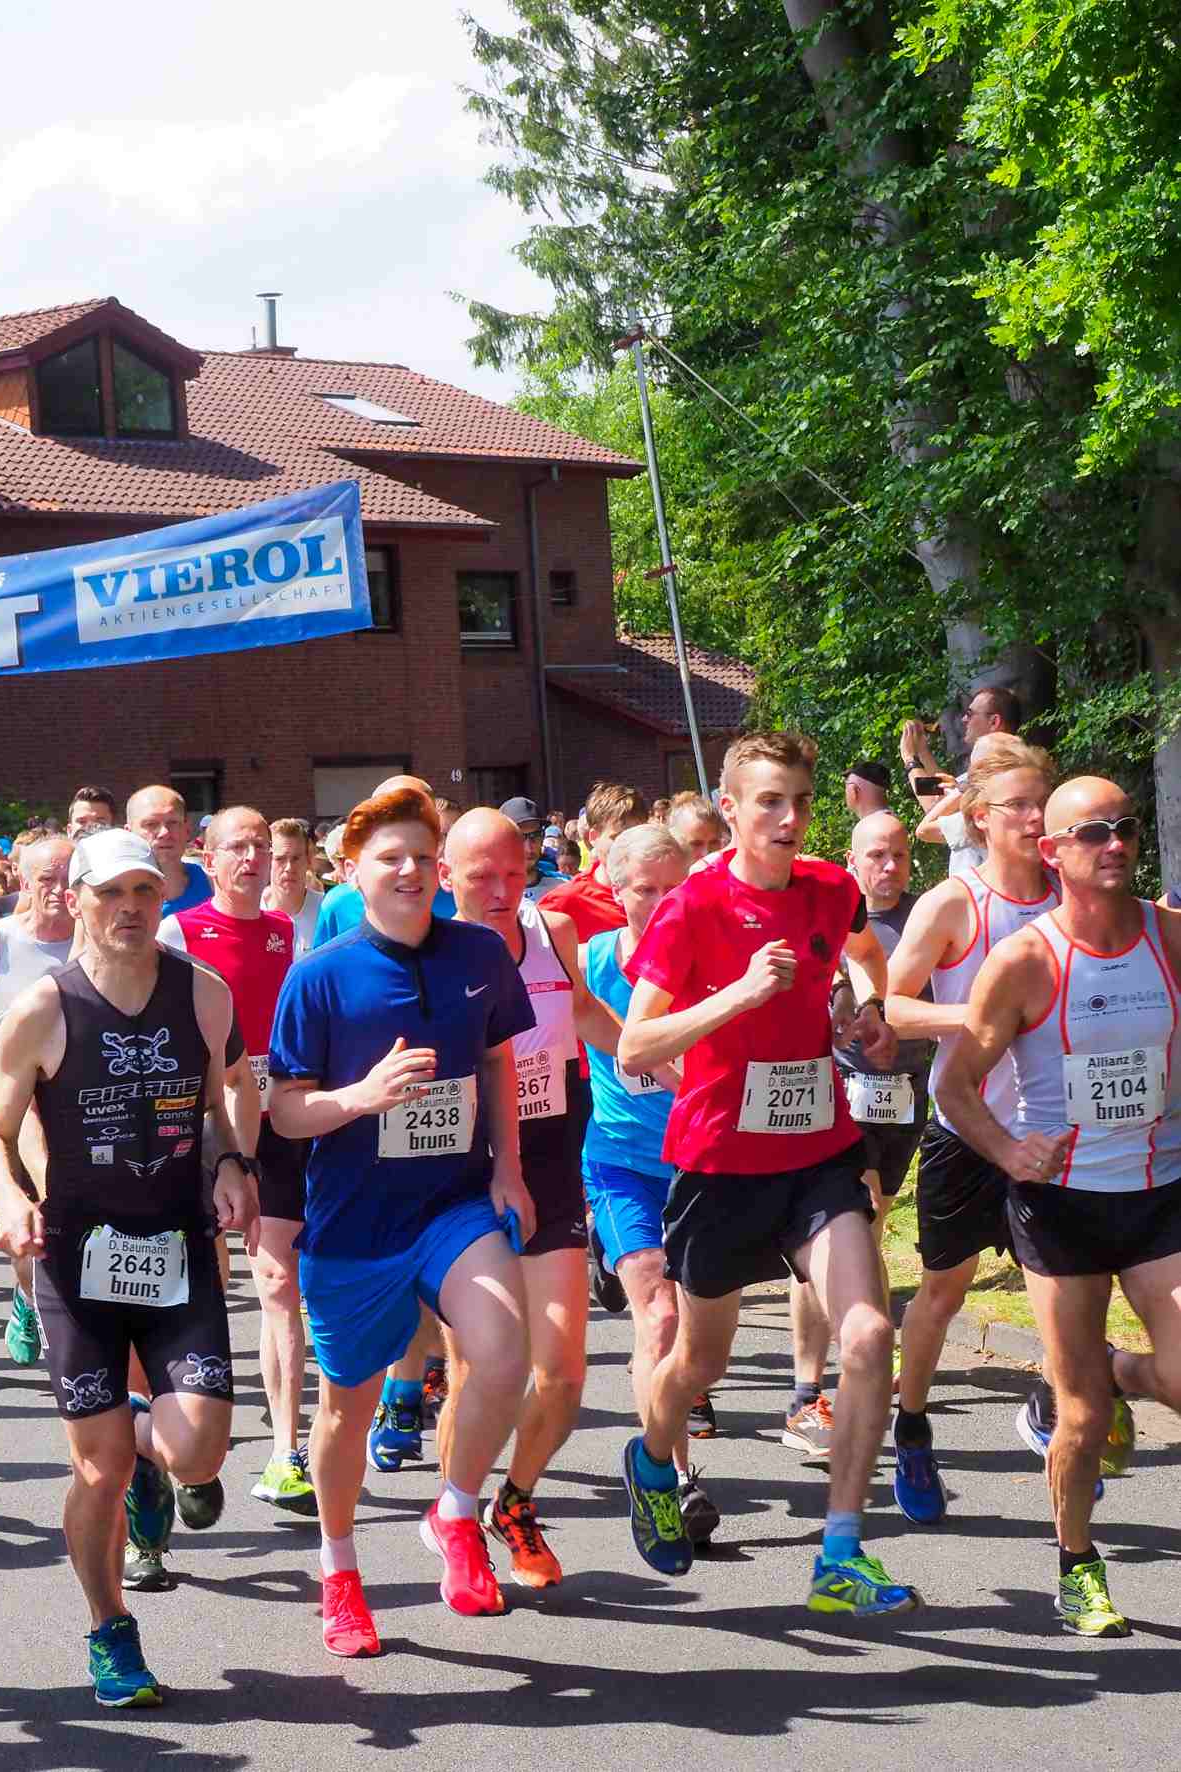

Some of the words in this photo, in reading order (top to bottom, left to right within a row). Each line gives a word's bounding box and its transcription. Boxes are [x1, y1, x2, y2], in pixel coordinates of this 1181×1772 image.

[83, 533, 343, 608] VIEROL
[99, 583, 347, 628] AKTIENGESELLSCHAFT
[1087, 1056, 1130, 1068] Allianz
[78, 1076, 201, 1105] PIRATE
[518, 1074, 551, 1098] 867
[1091, 1076, 1147, 1100] 2104
[768, 1087, 815, 1107] 2071
[875, 1090, 892, 1104] 34
[85, 1103, 126, 1116] uvex
[518, 1099, 551, 1117] runs
[866, 1104, 897, 1119] bruns
[1096, 1102, 1145, 1120] bruns
[405, 1107, 460, 1130] 2438
[768, 1110, 811, 1127] bruns
[409, 1131, 457, 1150] bruns
[122, 1241, 170, 1257] Baumann
[108, 1253, 167, 1277] 2643
[110, 1275, 161, 1298] bruns
